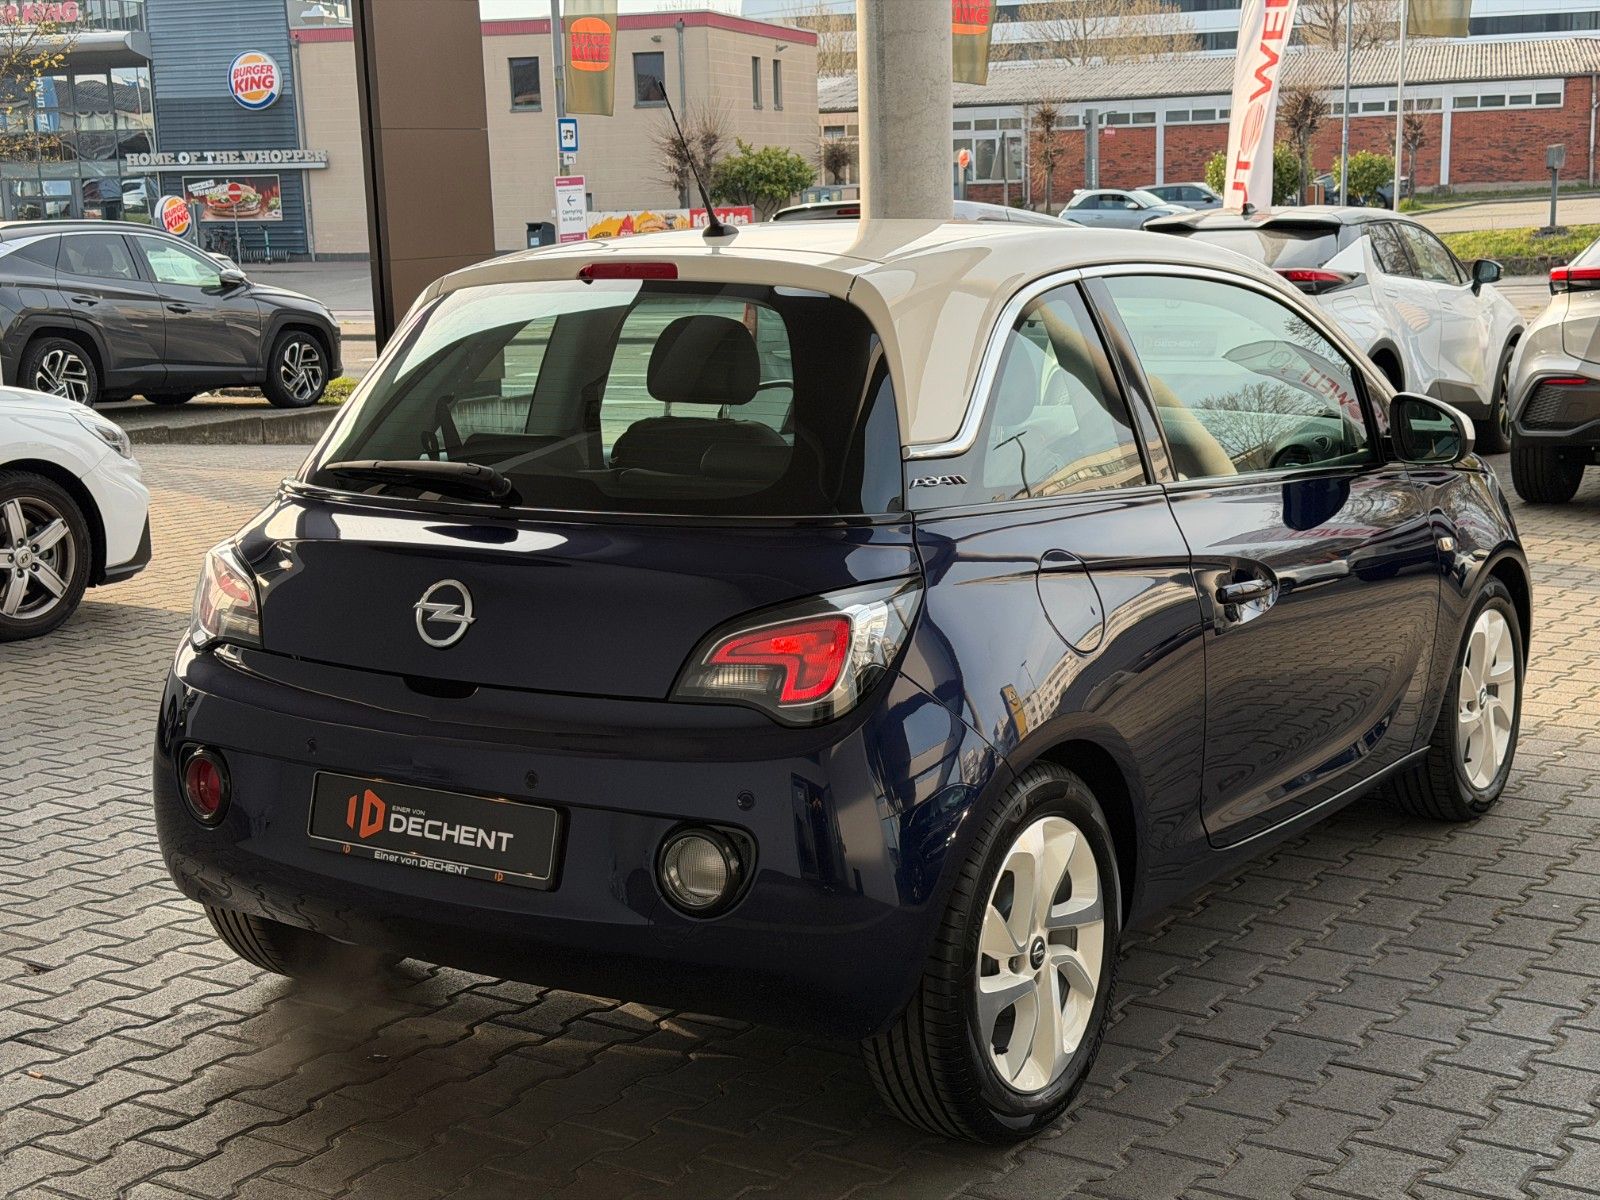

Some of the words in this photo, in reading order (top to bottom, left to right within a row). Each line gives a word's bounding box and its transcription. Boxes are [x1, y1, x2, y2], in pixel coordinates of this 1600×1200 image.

[233, 65, 274, 80] BURGER
[234, 75, 275, 94] KING
[125, 153, 176, 166] HOME
[178, 152, 201, 165] OF
[203, 151, 241, 164] THE
[241, 150, 328, 163] WHOPPER
[167, 210, 188, 230] KING
[392, 805, 411, 814] EINER
[412, 809, 426, 817] VON
[388, 813, 514, 852] DECHENT
[374, 850, 399, 863] Einer
[400, 857, 418, 868] von
[419, 859, 470, 875] DECHENT
